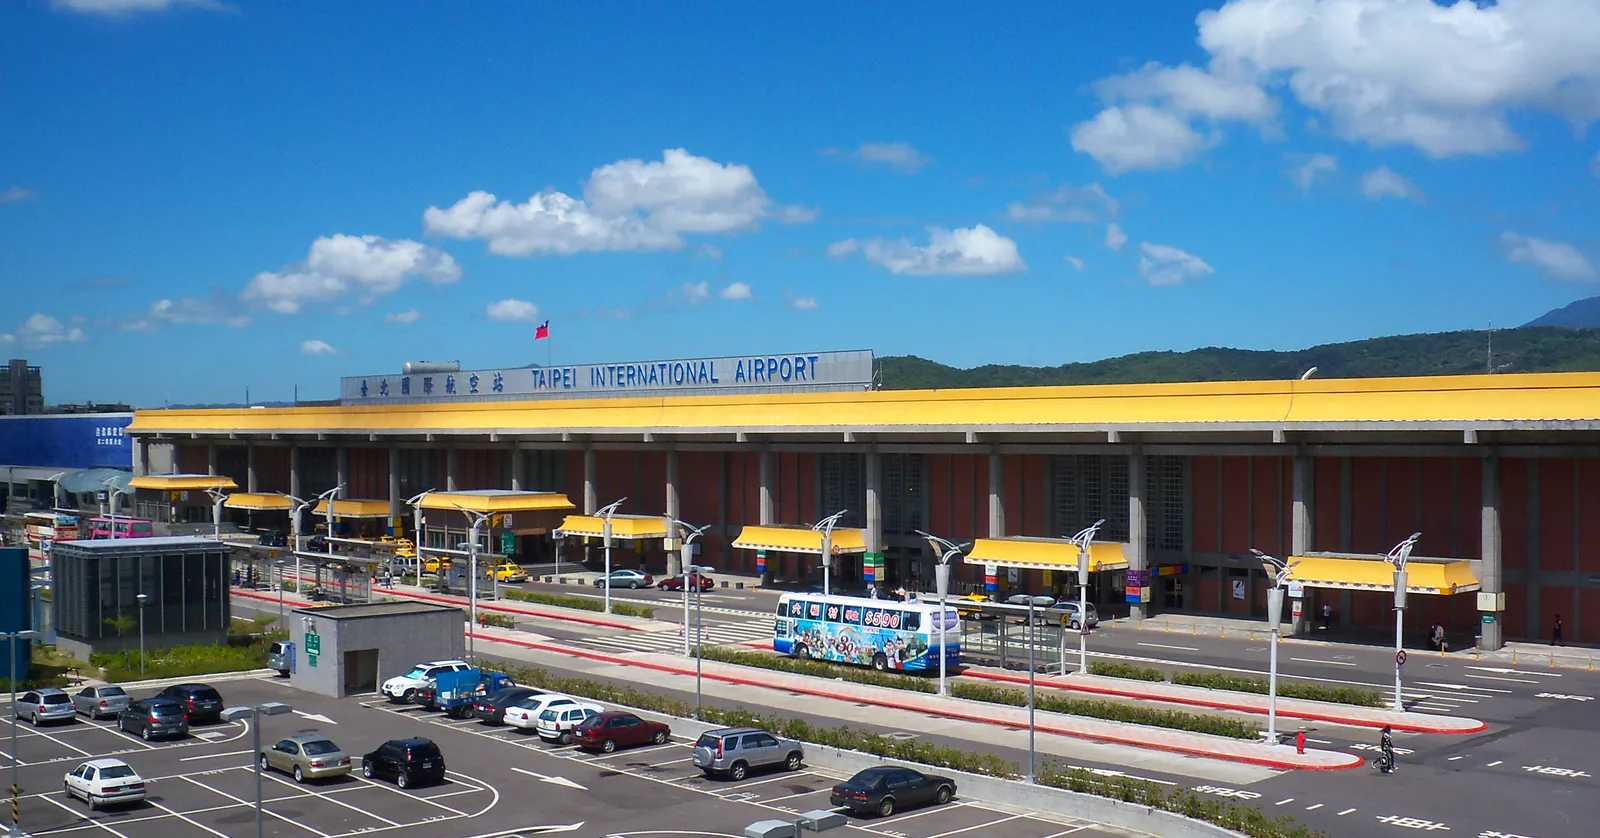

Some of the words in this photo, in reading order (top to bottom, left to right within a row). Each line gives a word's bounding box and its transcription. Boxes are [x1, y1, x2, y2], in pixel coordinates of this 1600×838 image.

[532, 368, 577, 389] TAIPEI
[590, 361, 719, 387] INTERNATIONAL
[735, 356, 819, 383] AIRPORT
[865, 611, 900, 629] $590
